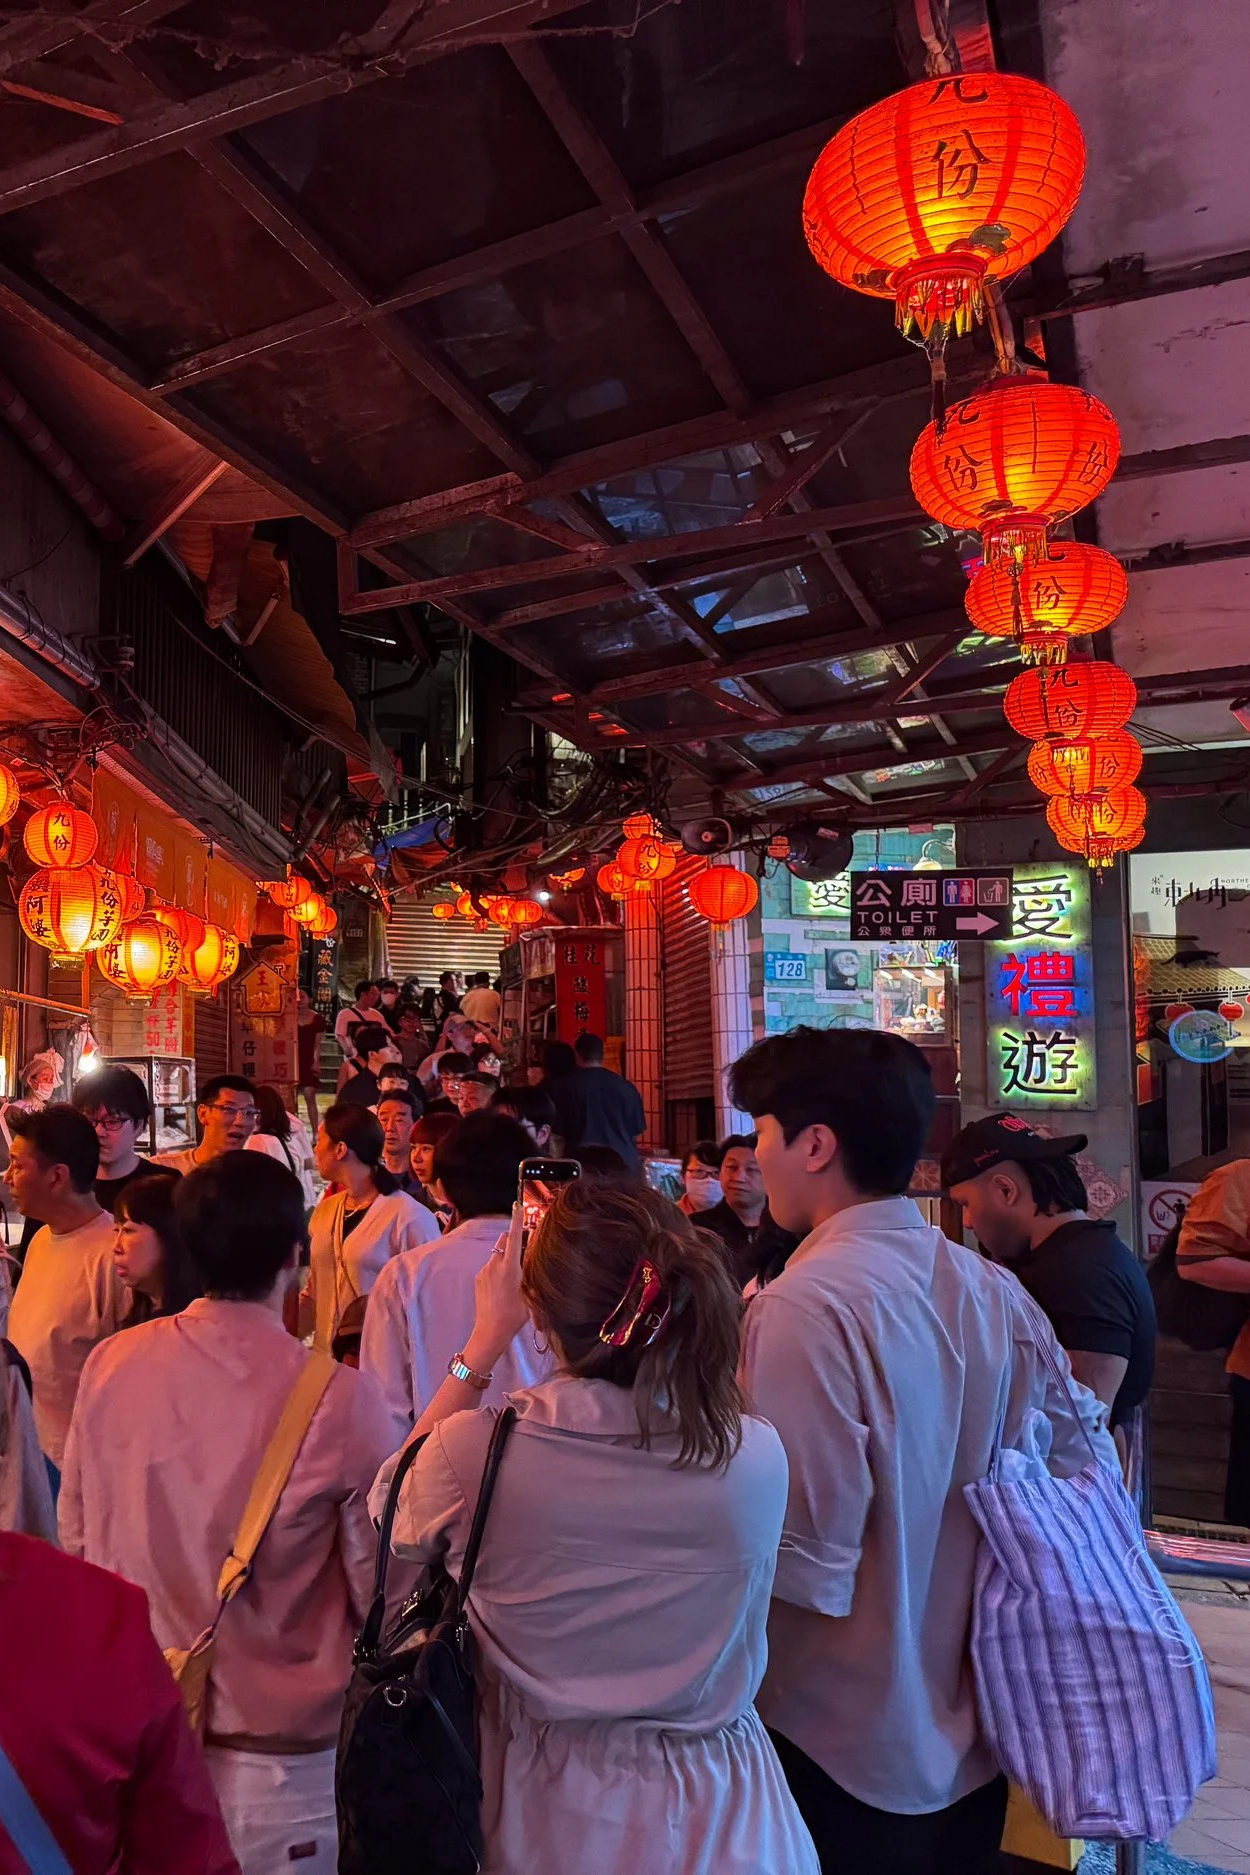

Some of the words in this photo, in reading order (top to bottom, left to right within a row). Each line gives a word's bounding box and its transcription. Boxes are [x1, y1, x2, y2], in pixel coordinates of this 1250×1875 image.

[927, 77, 990, 199] 九份
[1033, 551, 1066, 610] 份
[1050, 668, 1083, 727] 九份
[52, 812, 71, 851] 九份
[856, 910, 939, 924] TOILET
[104, 929, 126, 979] 阿婆
[778, 963, 803, 977] 128
[1000, 873, 1080, 1097] 愛禮遊
